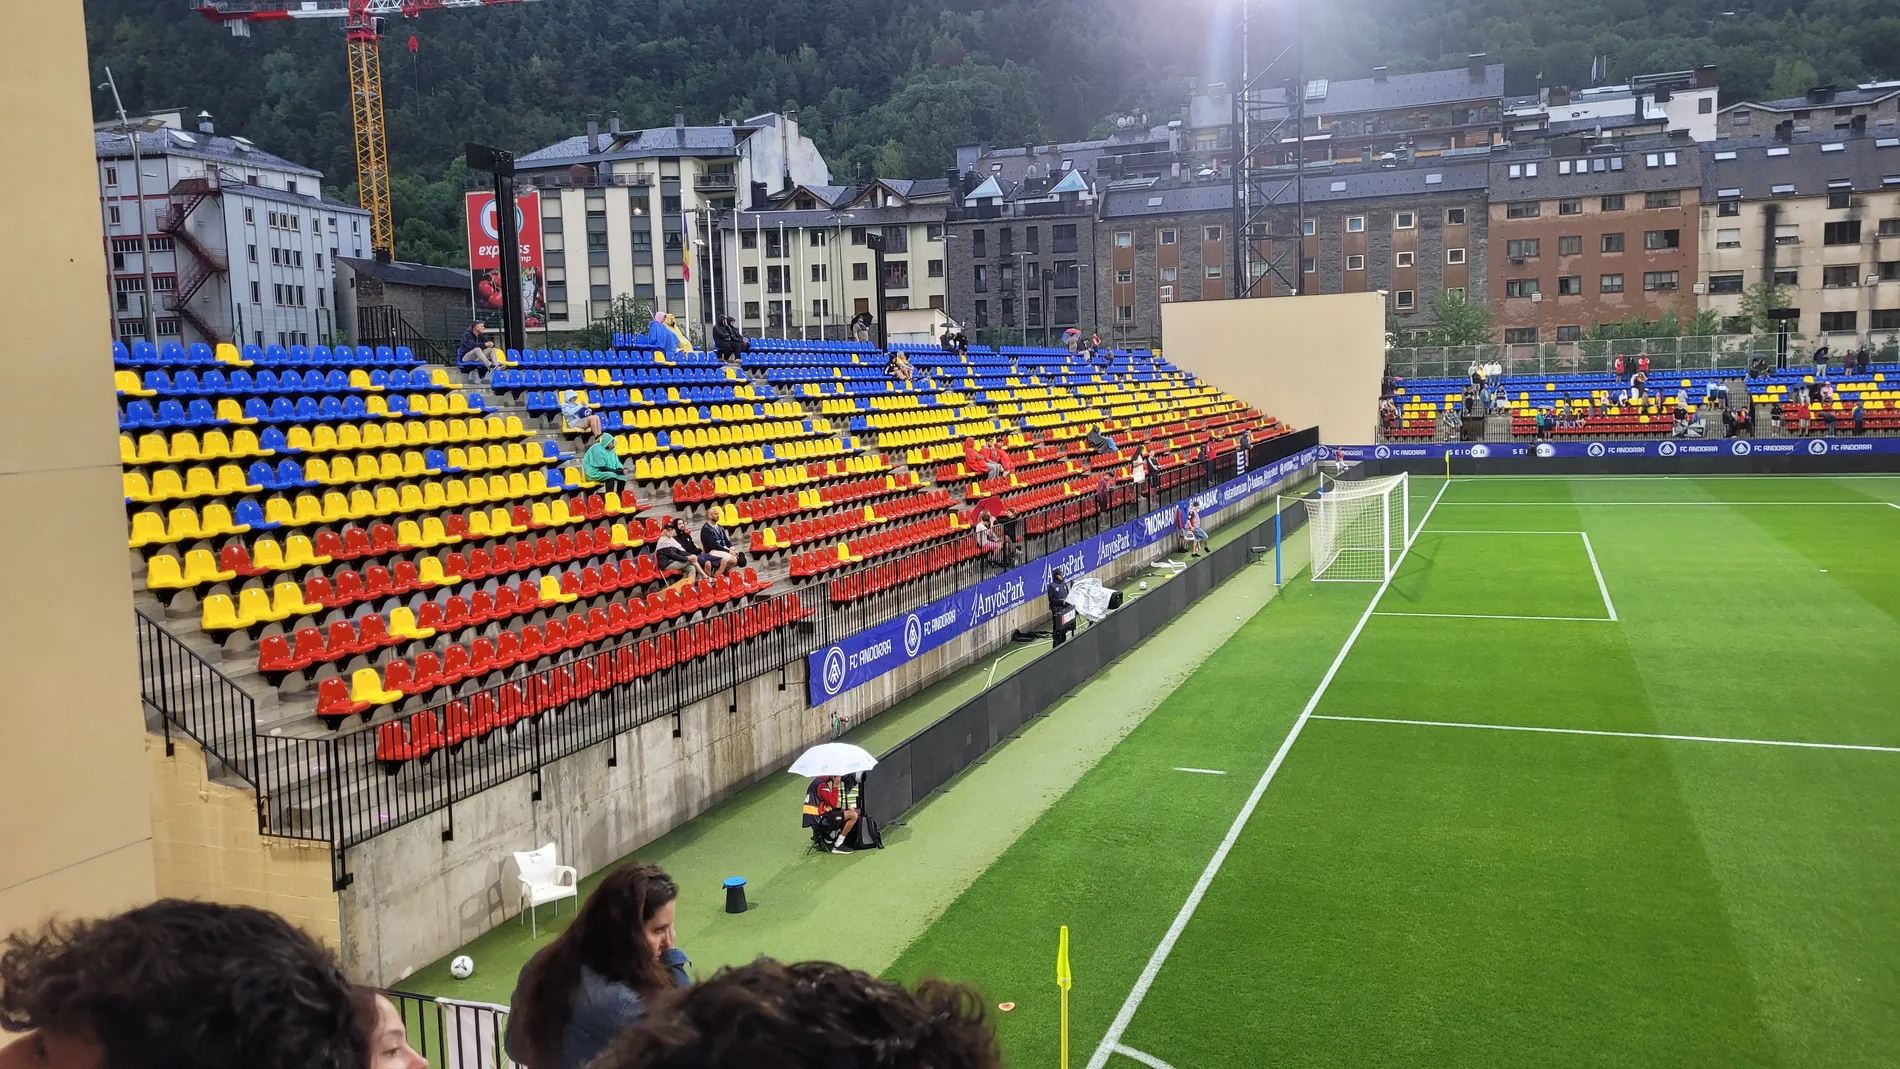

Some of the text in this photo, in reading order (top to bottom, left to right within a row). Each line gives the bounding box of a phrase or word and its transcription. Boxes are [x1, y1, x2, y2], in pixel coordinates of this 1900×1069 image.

[479, 244, 530, 258] expss
[1047, 550, 1085, 584] AósPark
[977, 576, 1025, 617] AnyósPark
[924, 609, 956, 636] FC ANDORRA
[850, 638, 892, 670] FC ANDORRA
